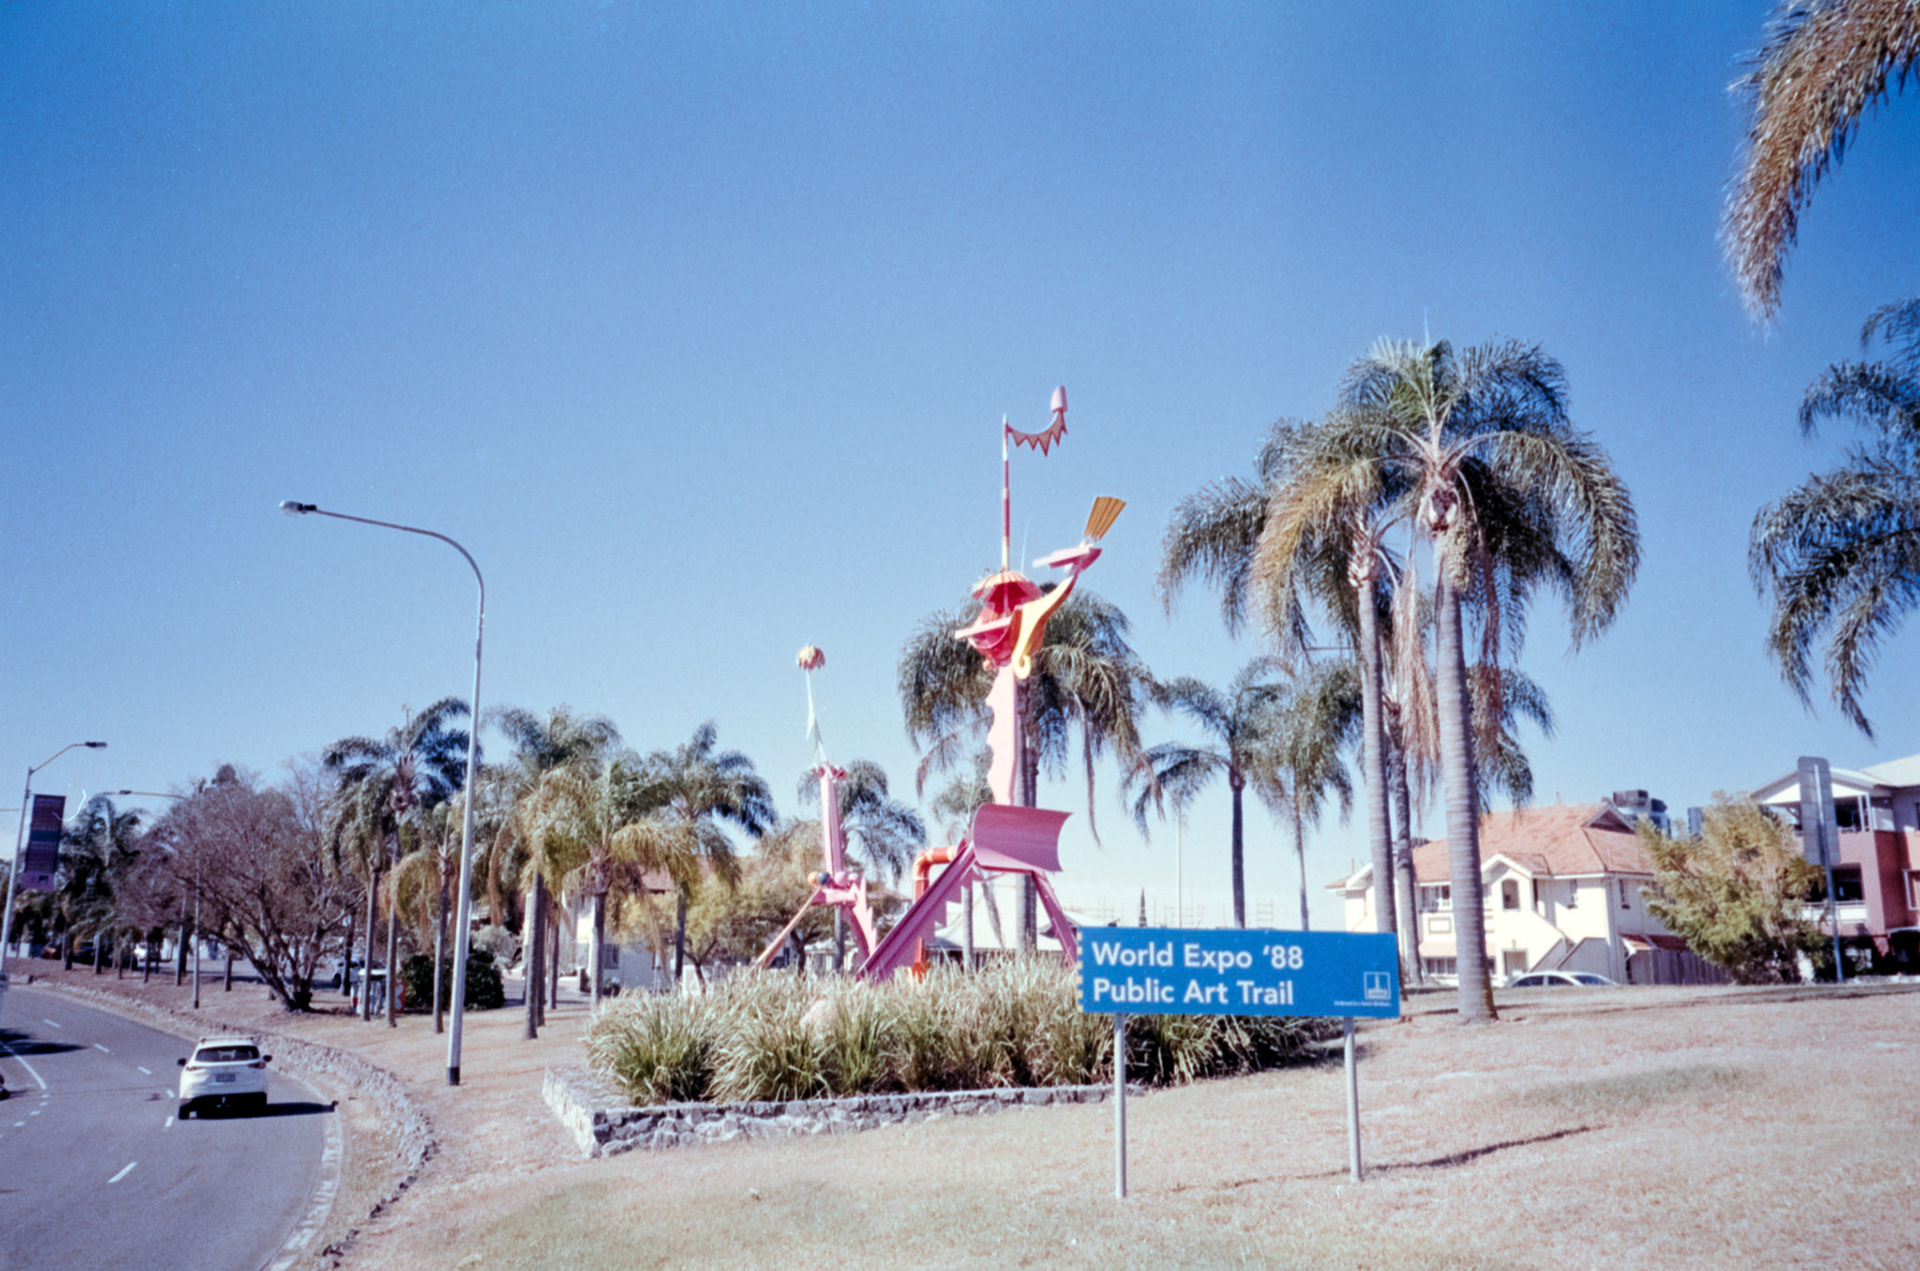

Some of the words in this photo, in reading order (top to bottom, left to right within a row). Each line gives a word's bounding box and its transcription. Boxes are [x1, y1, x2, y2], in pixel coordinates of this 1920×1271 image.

[1092, 941, 1173, 967] World
[1184, 943, 1253, 974] Expo
[1263, 944, 1304, 970] '88
[1093, 977, 1174, 1004] Public
[1183, 979, 1228, 1005] Art
[1237, 980, 1294, 1006] Trail
